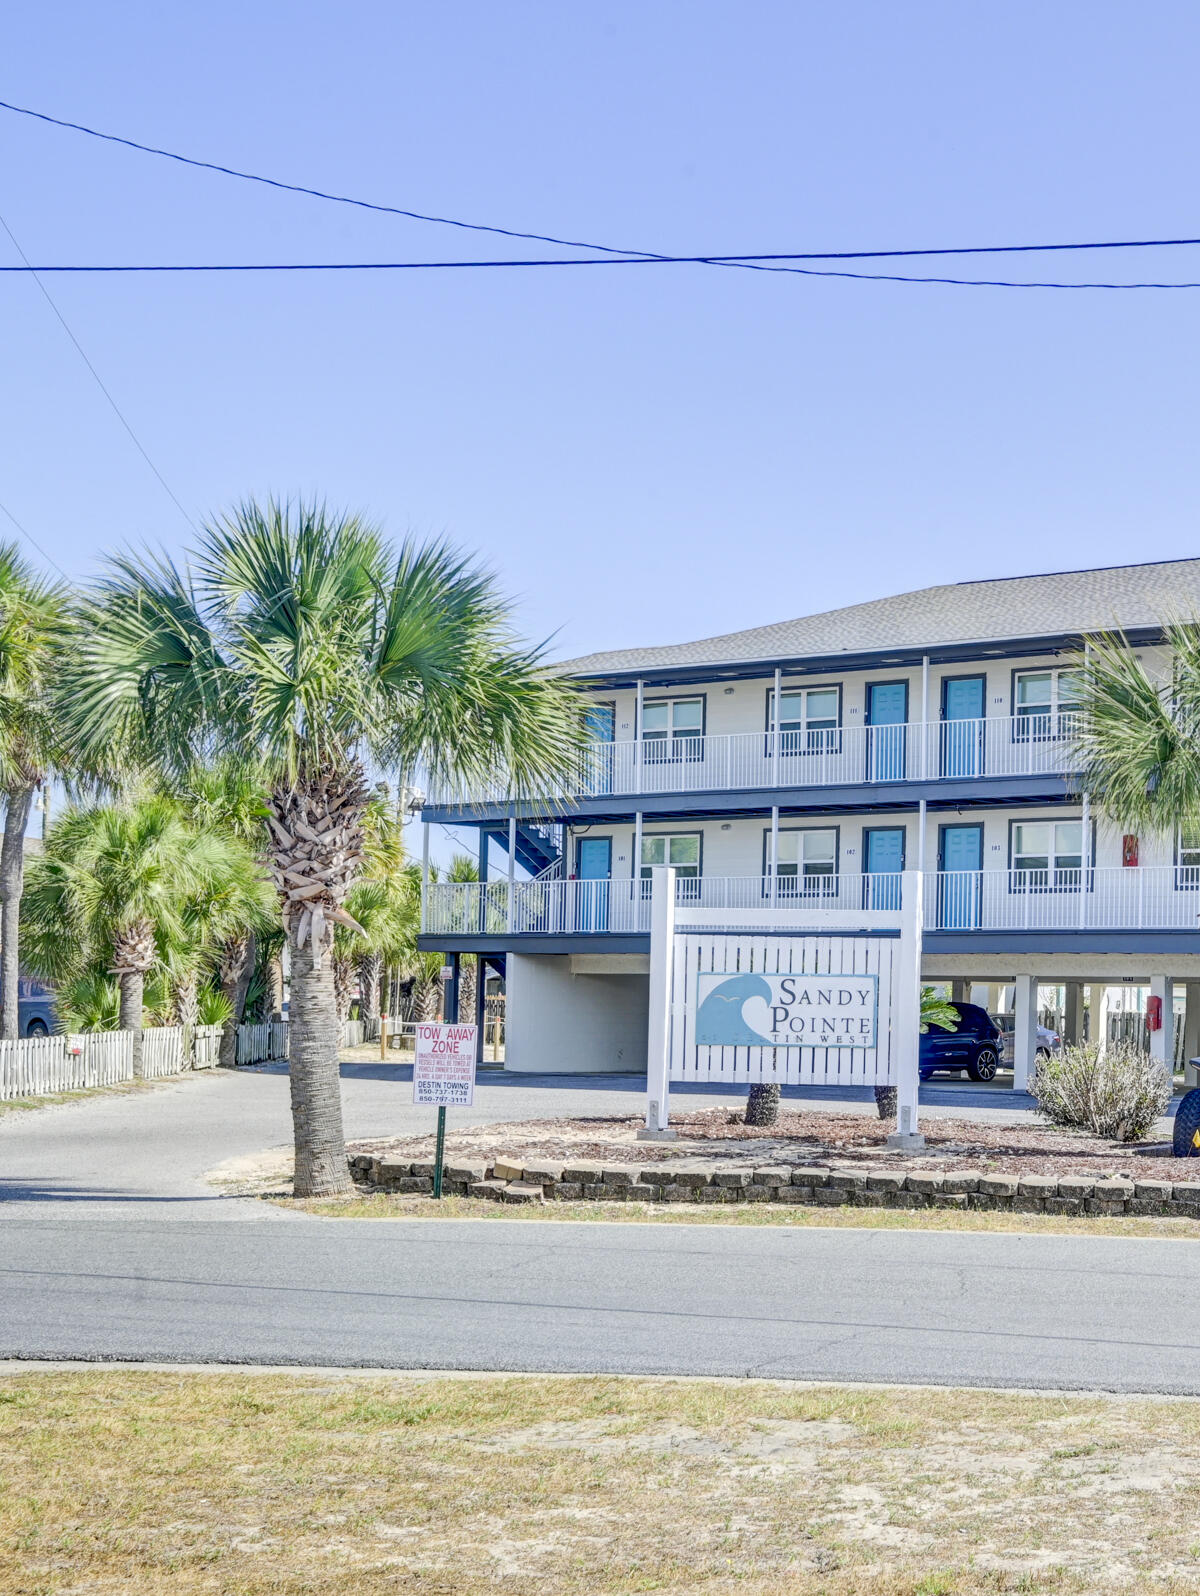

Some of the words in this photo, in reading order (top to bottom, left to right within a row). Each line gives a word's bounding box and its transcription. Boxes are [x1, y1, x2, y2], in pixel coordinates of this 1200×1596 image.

[779, 978, 870, 1006] SANDY
[769, 1006, 870, 1034] POINTE
[418, 1026, 441, 1040] TOW
[446, 1027, 474, 1041] AWAY
[820, 1035, 869, 1043] WEST
[431, 1040, 460, 1054] ZONE
[418, 1080, 441, 1089] DESTIN
[443, 1081, 469, 1090] TOWING
